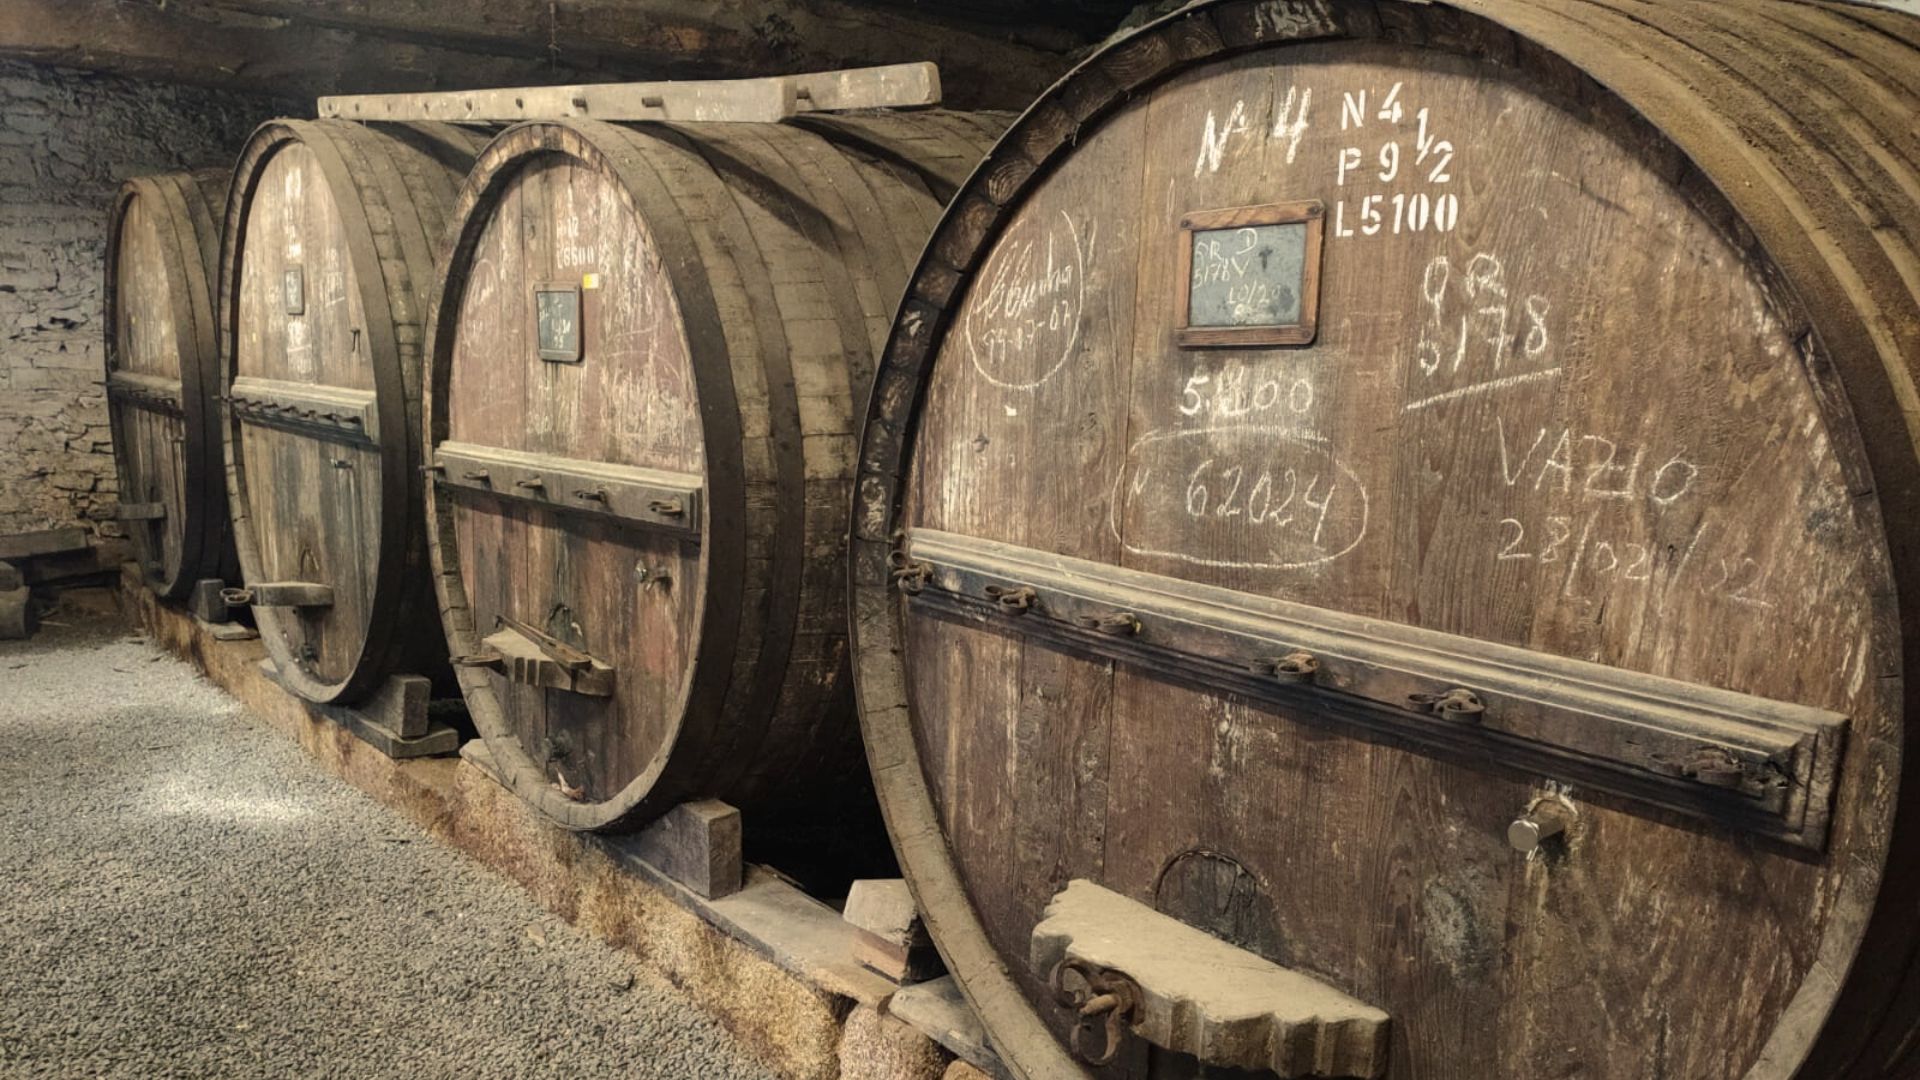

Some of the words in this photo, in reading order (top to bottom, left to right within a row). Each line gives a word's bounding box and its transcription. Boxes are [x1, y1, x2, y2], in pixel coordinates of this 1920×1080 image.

[1273, 86, 1312, 164] 4
[1341, 90, 1366, 130] N
[1378, 82, 1404, 124] 4
[1338, 148, 1362, 185] P
[1379, 142, 1400, 182] 9
